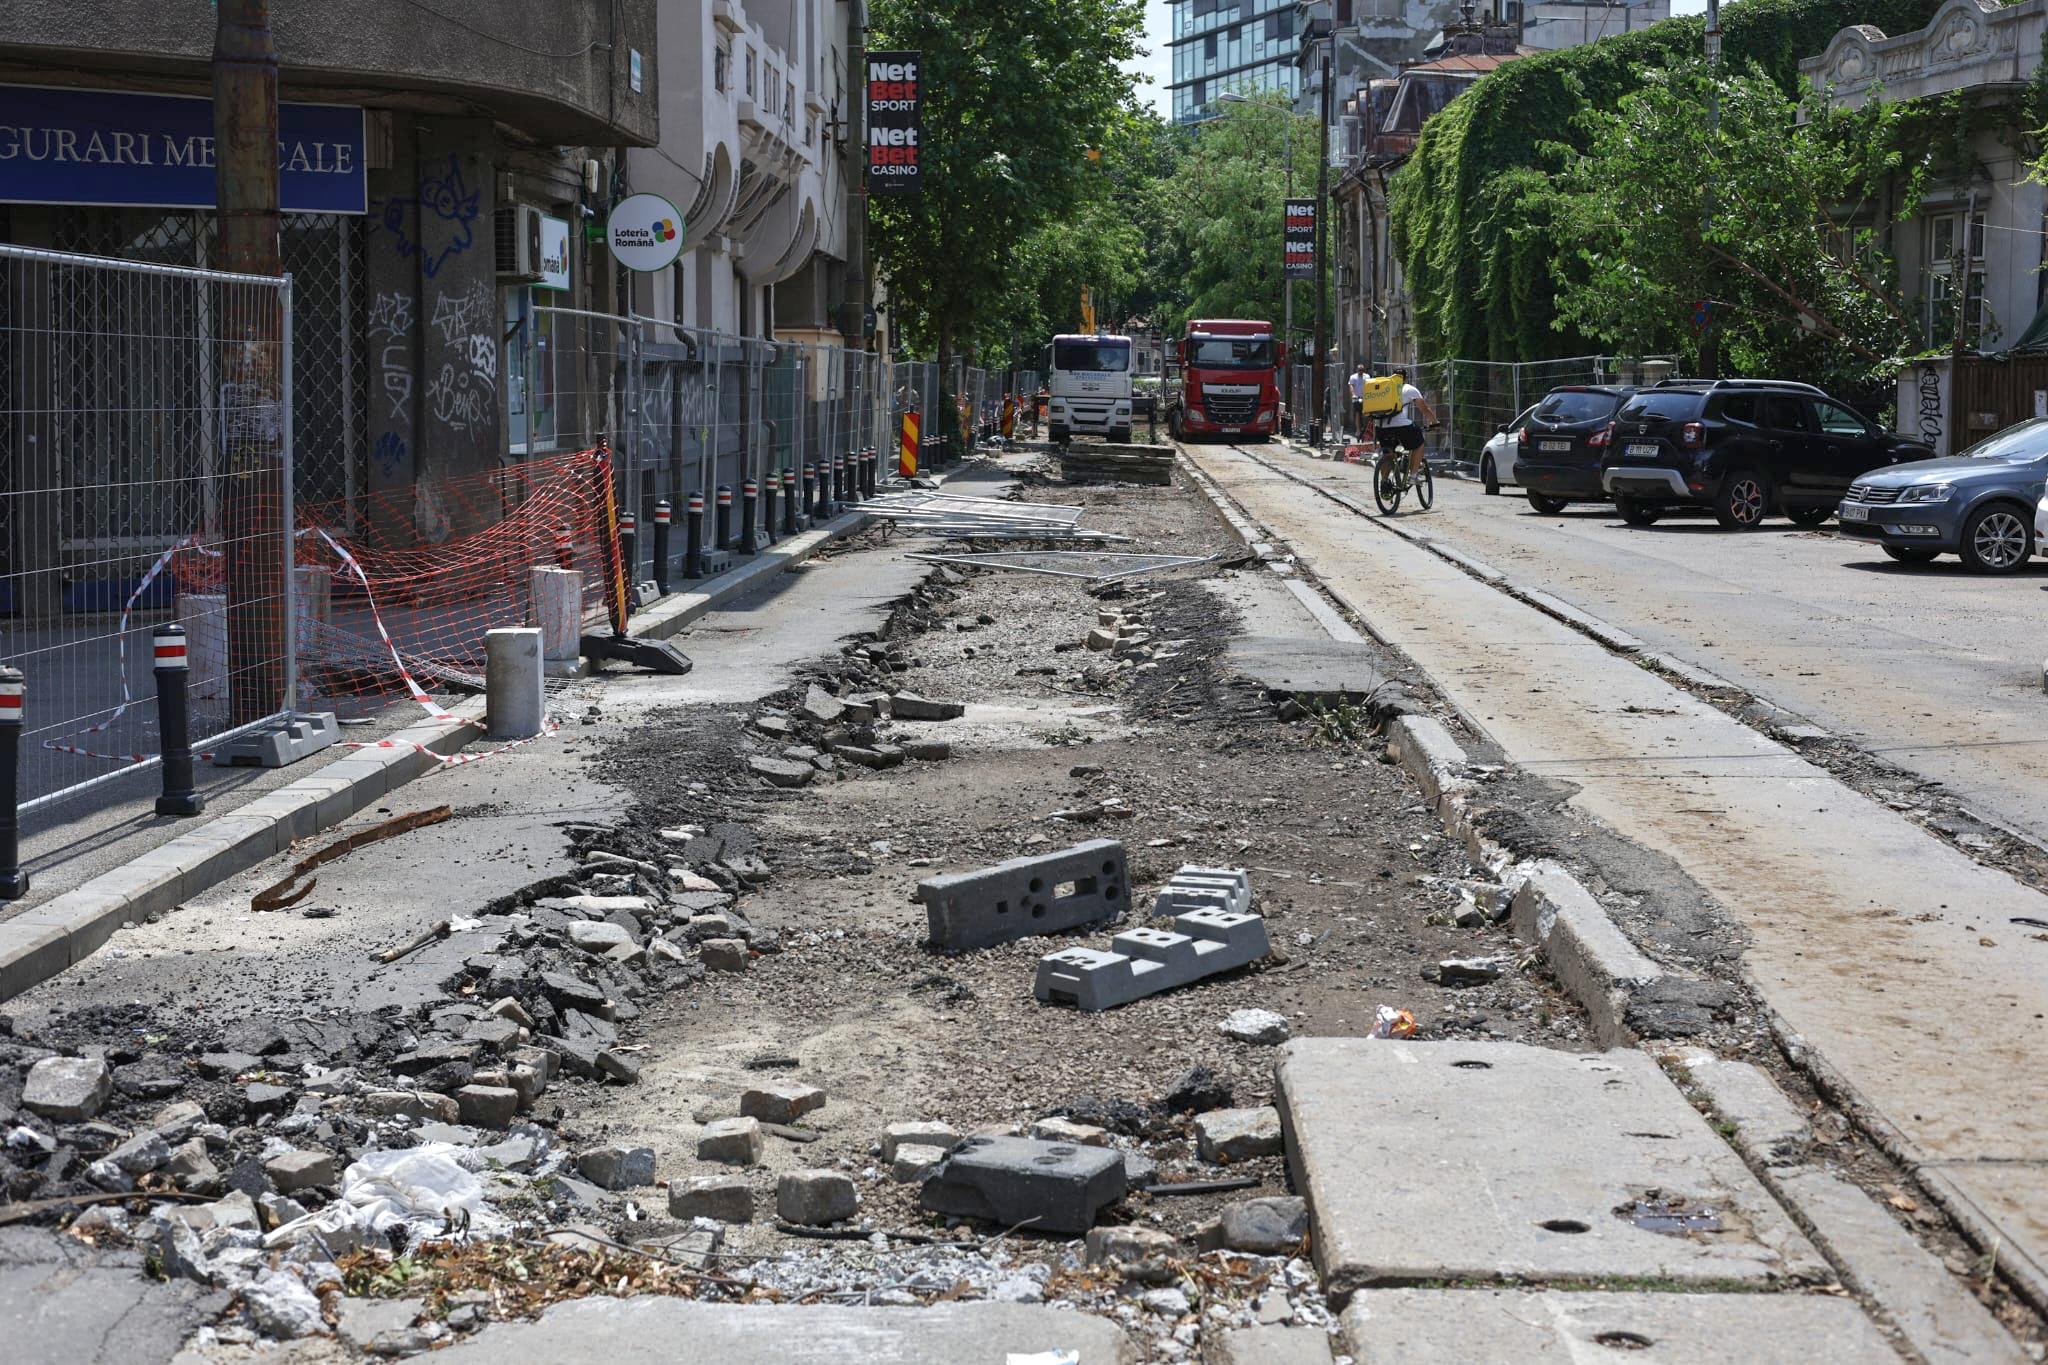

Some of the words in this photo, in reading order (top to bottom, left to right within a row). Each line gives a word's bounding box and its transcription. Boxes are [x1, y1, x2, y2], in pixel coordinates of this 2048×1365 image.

[870, 62, 917, 82] Net
[870, 81, 917, 100] Bet
[871, 100, 917, 111] SPORT
[870, 127, 918, 146] Net
[870, 146, 918, 165] Bet
[871, 165, 918, 175] CASINO
[1287, 205, 1314, 216] Net
[615, 228, 649, 237] Loteria
[615, 238, 654, 247] Română
[1286, 241, 1313, 253] Net
